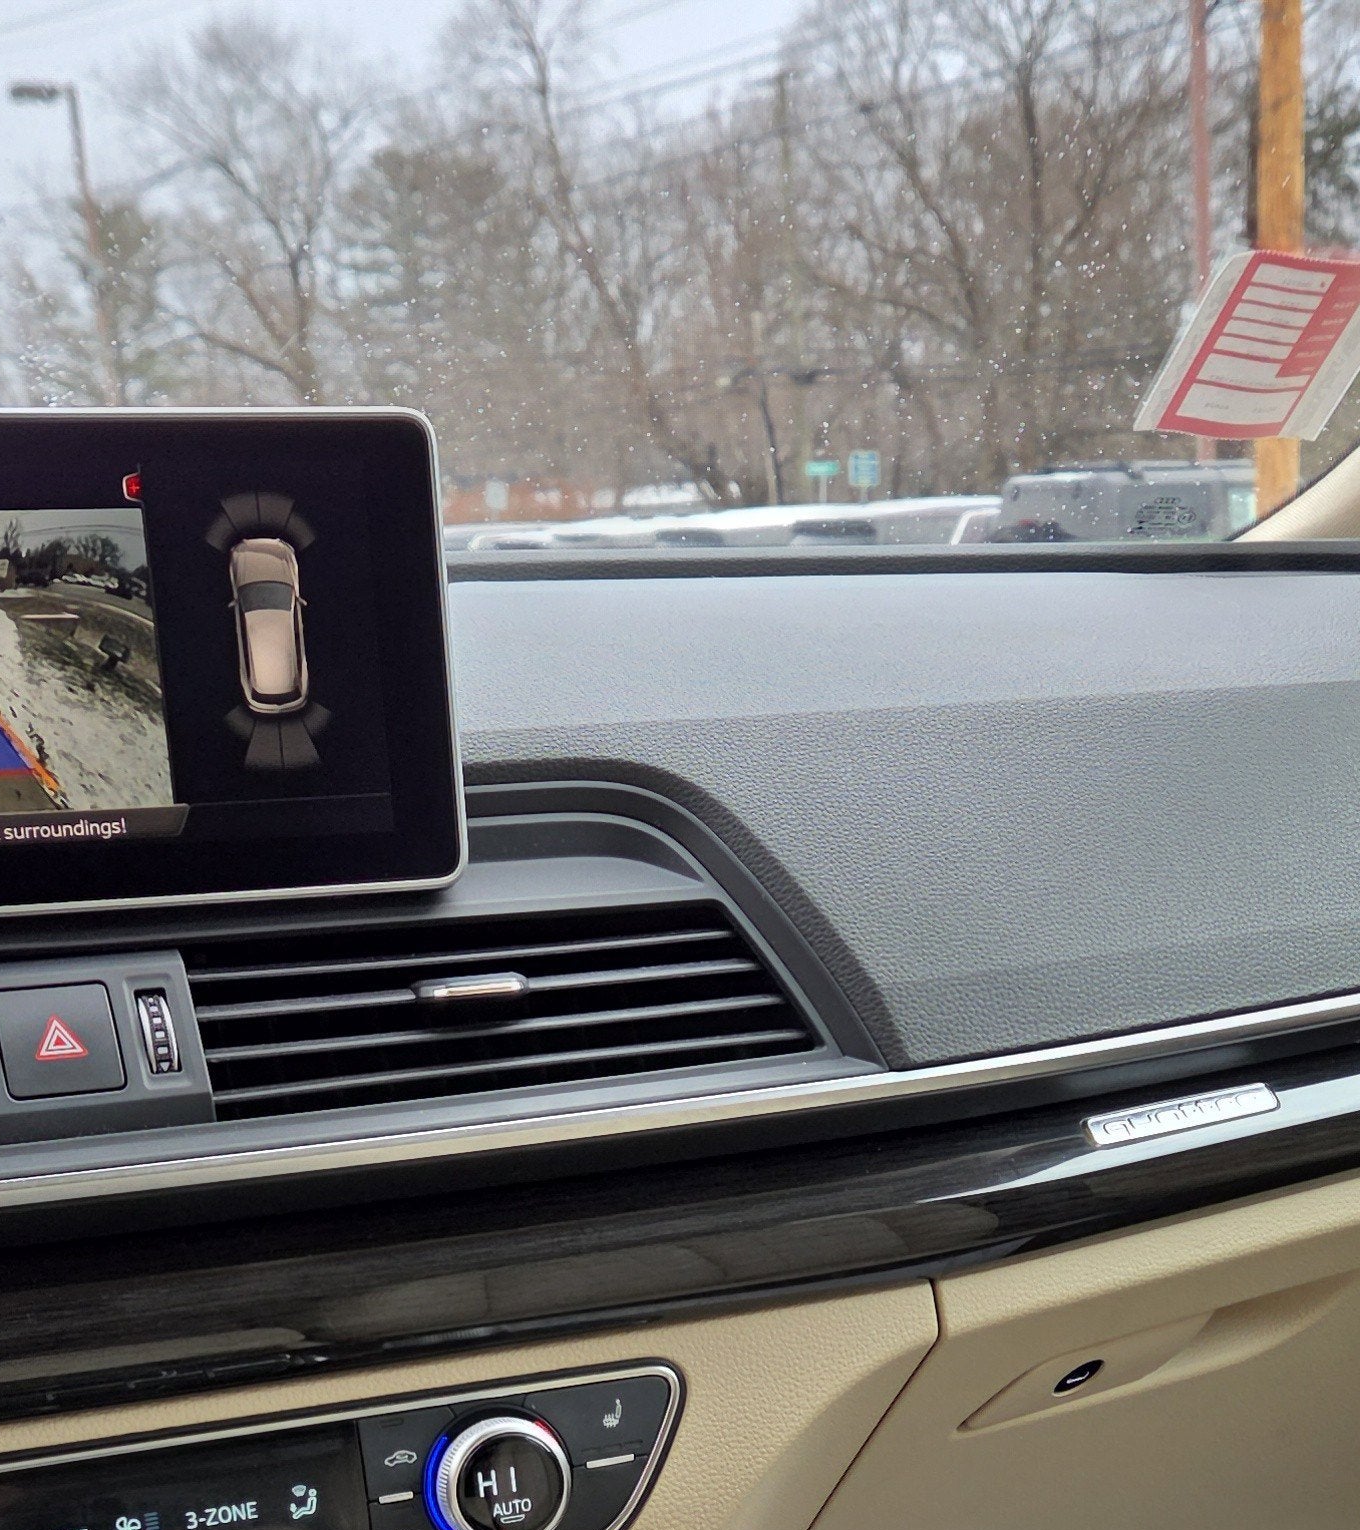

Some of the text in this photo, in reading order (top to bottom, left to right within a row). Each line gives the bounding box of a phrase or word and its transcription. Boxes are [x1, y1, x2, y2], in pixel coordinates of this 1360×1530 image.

[3, 818, 127, 843] surroundings!
[477, 1466, 517, 1498] HI
[185, 1501, 259, 1530] 3-ZONE
[493, 1498, 532, 1517] AUTO
